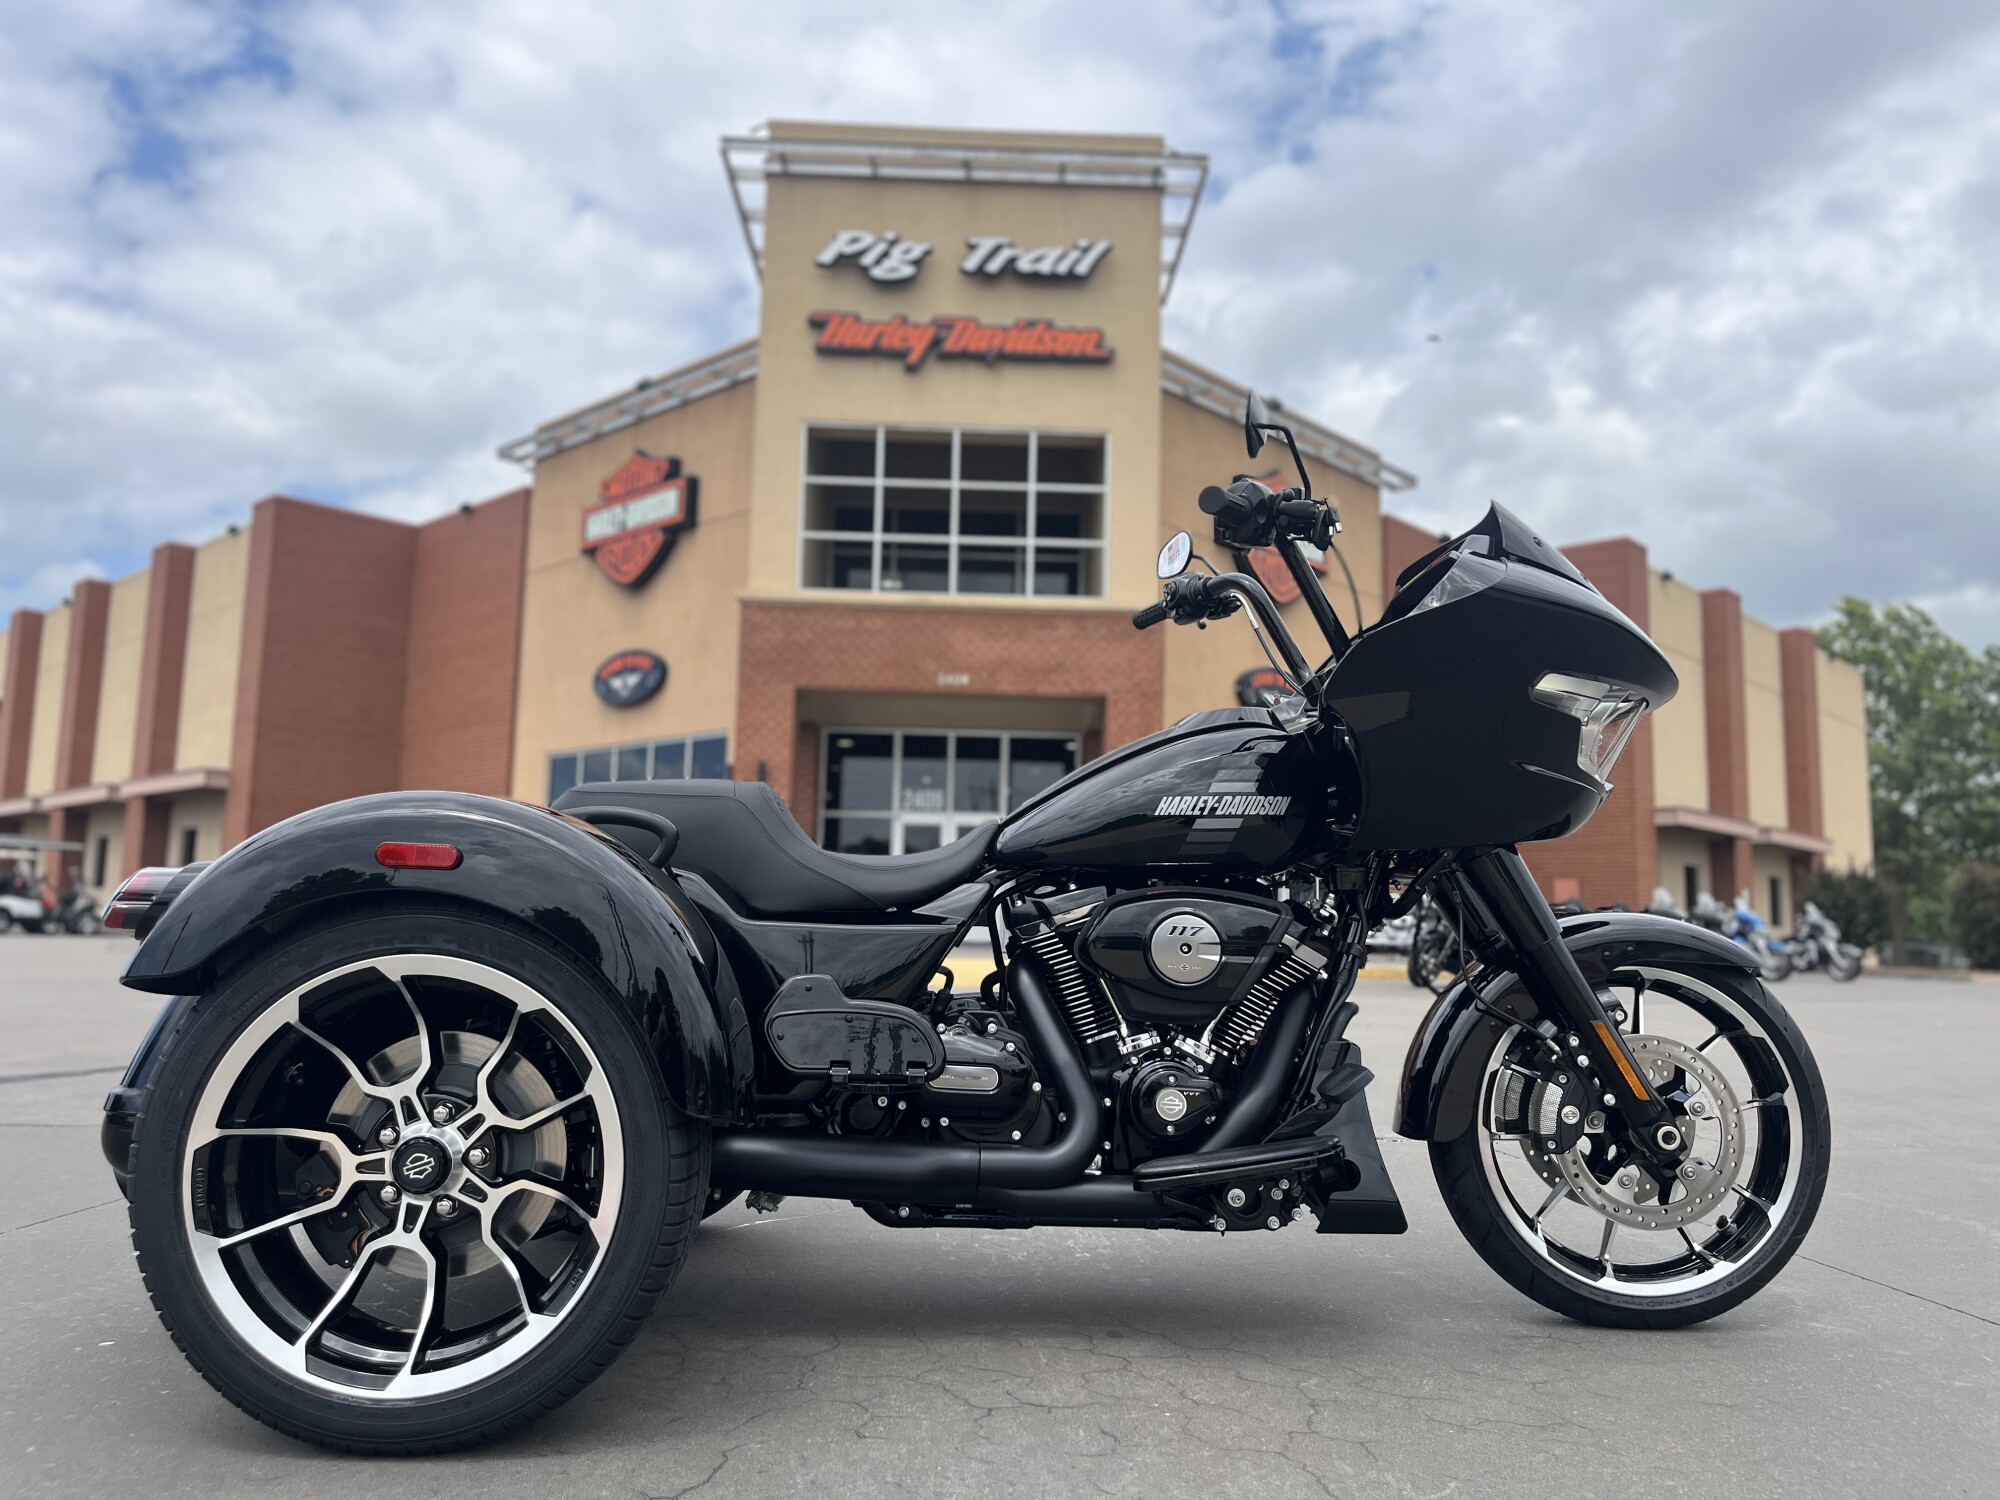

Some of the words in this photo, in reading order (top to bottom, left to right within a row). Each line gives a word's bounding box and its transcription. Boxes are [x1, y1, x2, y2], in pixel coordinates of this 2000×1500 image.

[815, 229, 932, 281] Pig
[960, 235, 1112, 277] Trail
[1154, 795, 1291, 816] HARLEY-DAVIDSON
[1167, 925, 1205, 938] 117
